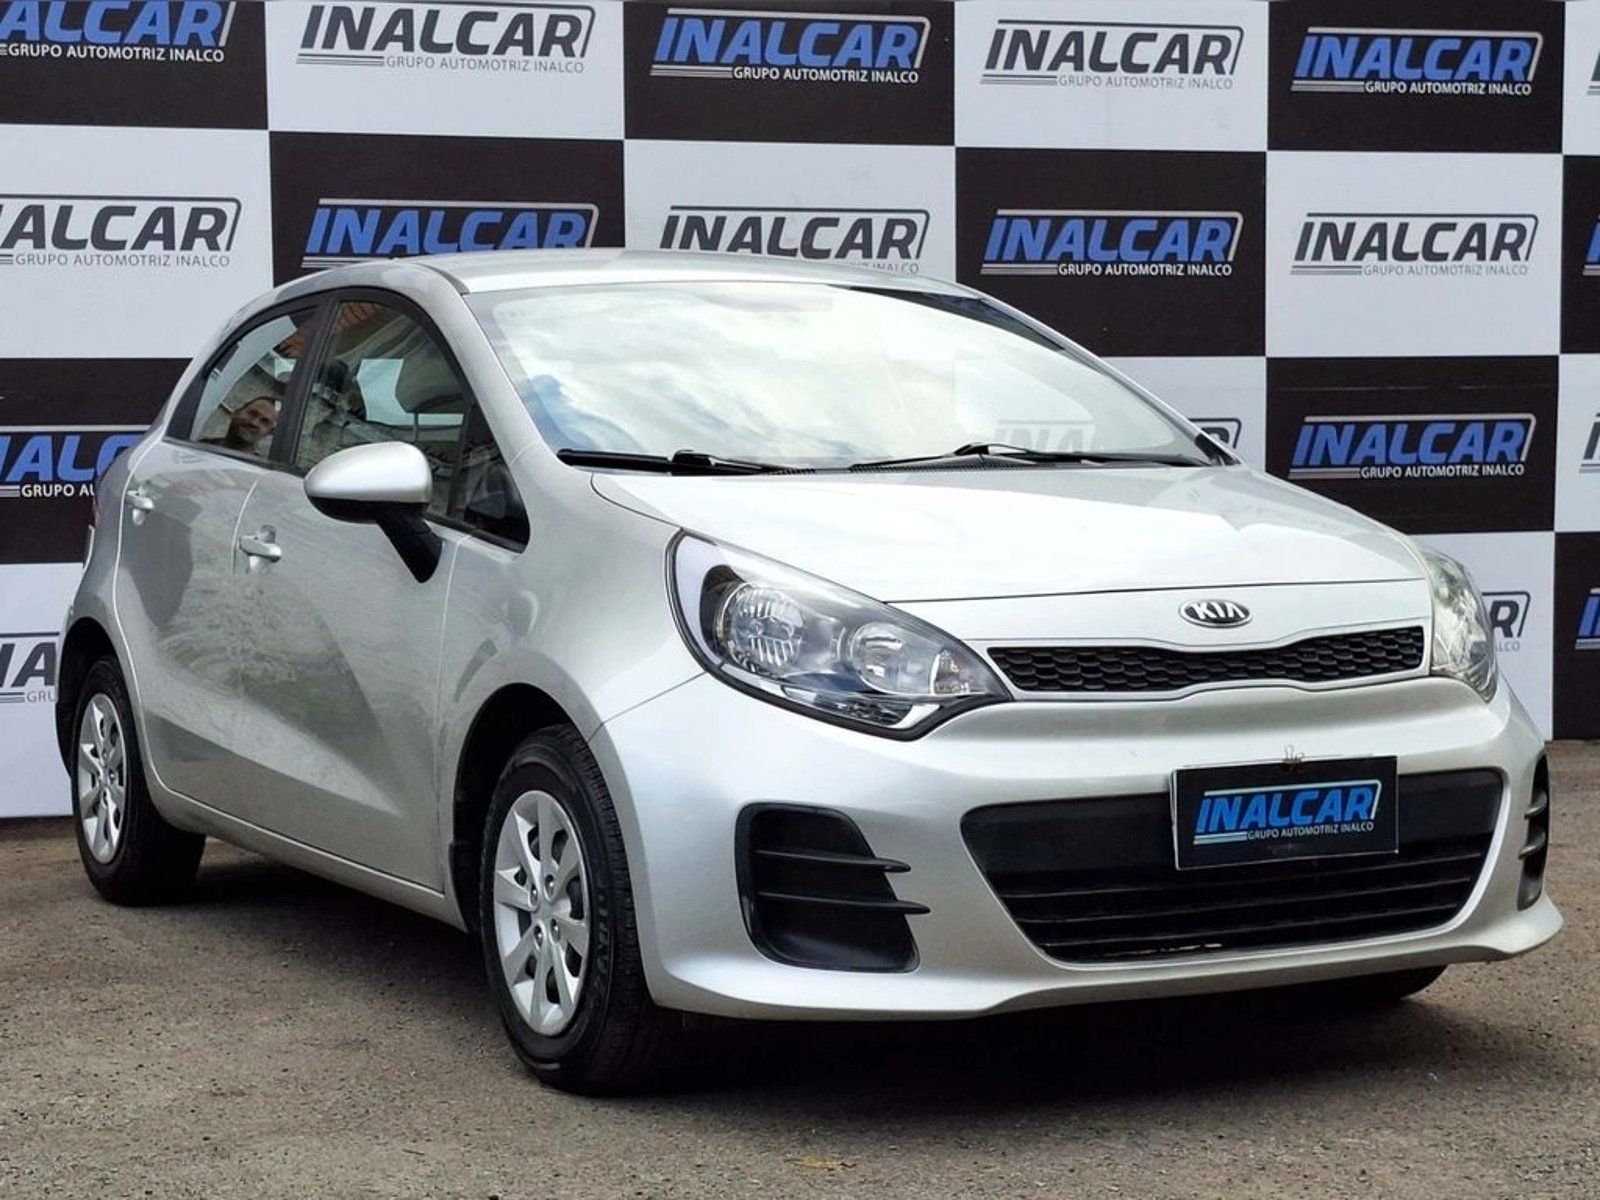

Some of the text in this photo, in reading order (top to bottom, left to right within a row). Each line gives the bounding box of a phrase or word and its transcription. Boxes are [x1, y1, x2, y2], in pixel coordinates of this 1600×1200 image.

[300, 5, 582, 58] INALCAR
[8, 43, 225, 63] GRUPO AUTOMOTRIZ INALCO
[653, 17, 919, 69] INALCAR
[984, 29, 1232, 75] INALCAR
[385, 55, 584, 74] GRUPO AUTOMOTRIZ INALCO
[1295, 35, 1532, 81] INALCAR
[733, 66, 919, 84] GRUPO AUTOMOTRIZ INALCO
[1058, 75, 1233, 90] GRUPO AUTOMOTRIZ INALCO
[1364, 81, 1532, 96] GRUPO AUTOMOTRIZ INALCO
[0, 204, 228, 251] ALCAR
[305, 208, 587, 254] INALCAR
[659, 215, 918, 260] INALCAR
[984, 218, 1232, 262] INALCAR
[1294, 222, 1528, 262] INALCAR
[15, 253, 230, 268] GRUPO AUTOMOTRIZ INALCO
[1058, 263, 1232, 276] GRUPO AUTOMOTRIZ INALCO
[1363, 265, 1528, 276] GRUPO AUTOMOTRIZ INALCO
[1292, 421, 1525, 466] INALCAR
[1360, 463, 1525, 479] GRUPO AUTOMOTRIZ INALCO
[21, 483, 75, 498] GRUPO
[1192, 601, 1246, 619] KIA
[1195, 786, 1373, 833] INALCAR
[1247, 821, 1375, 840] GRUPO AUTOMOTRIZ INALCO
